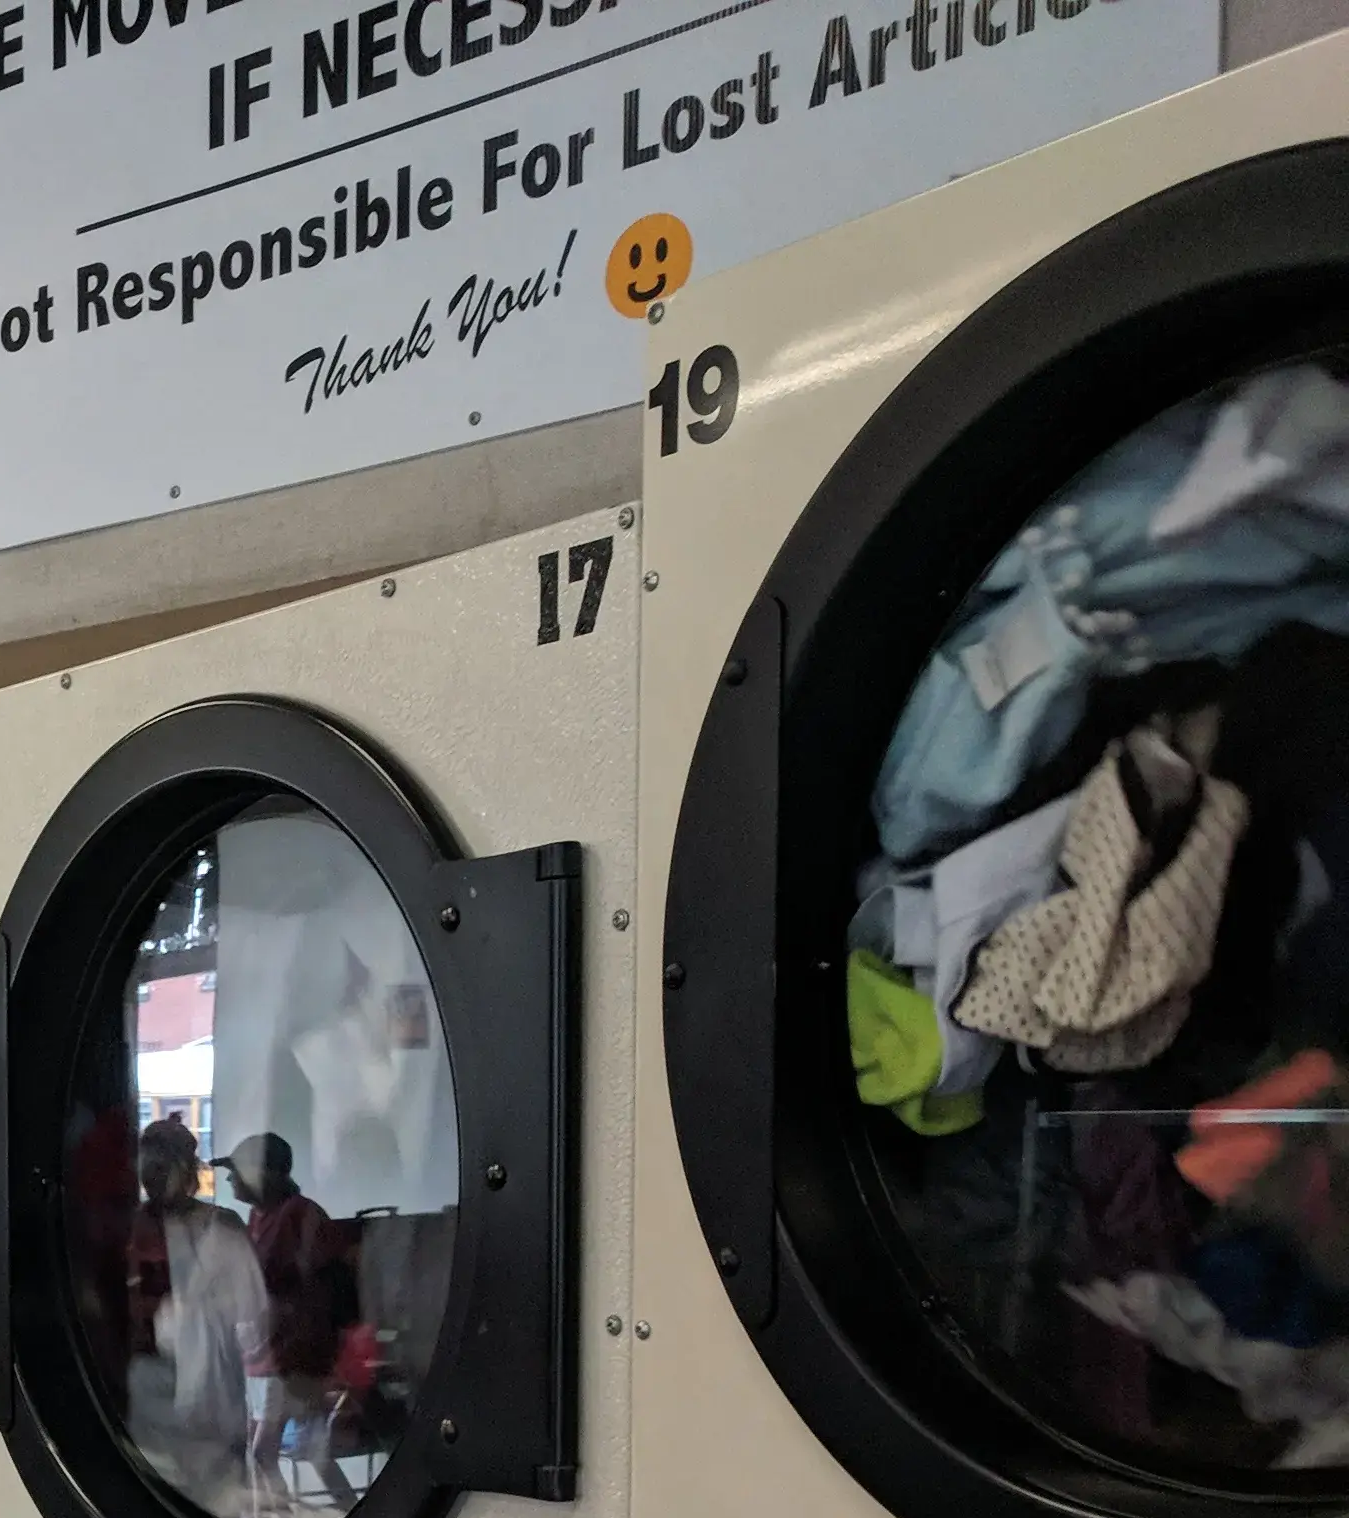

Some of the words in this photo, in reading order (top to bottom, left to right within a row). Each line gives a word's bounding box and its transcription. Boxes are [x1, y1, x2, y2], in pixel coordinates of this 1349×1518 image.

[53, 0, 244, 71] MO
[208, 46, 273, 151] IF
[303, 0, 617, 118] NECES
[76, 165, 453, 332] Responsible
[482, 127, 594, 213] For
[623, 50, 781, 171] Lost
[285, 298, 434, 414] Thank
[447, 228, 578, 358] You!
[649, 344, 739, 458] 19
[537, 535, 613, 646] 17
